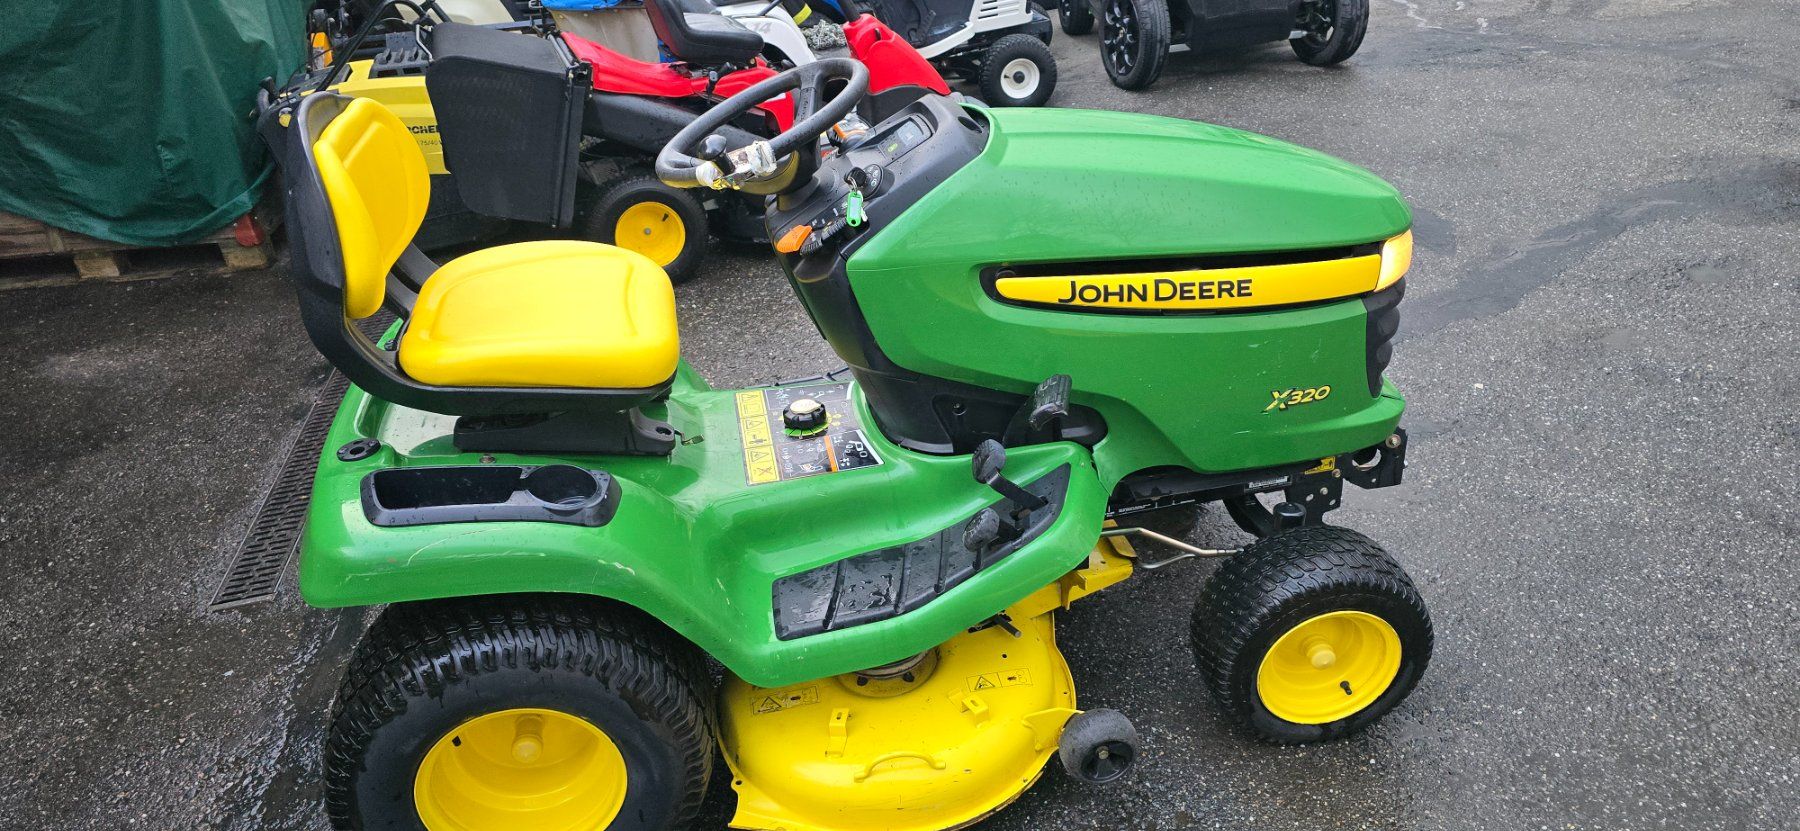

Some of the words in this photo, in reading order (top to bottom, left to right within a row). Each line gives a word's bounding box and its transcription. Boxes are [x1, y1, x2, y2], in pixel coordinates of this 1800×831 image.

[1057, 280, 1148, 303] JOHN
[1153, 278, 1253, 302] DEERE
[1262, 384, 1332, 412] X320
